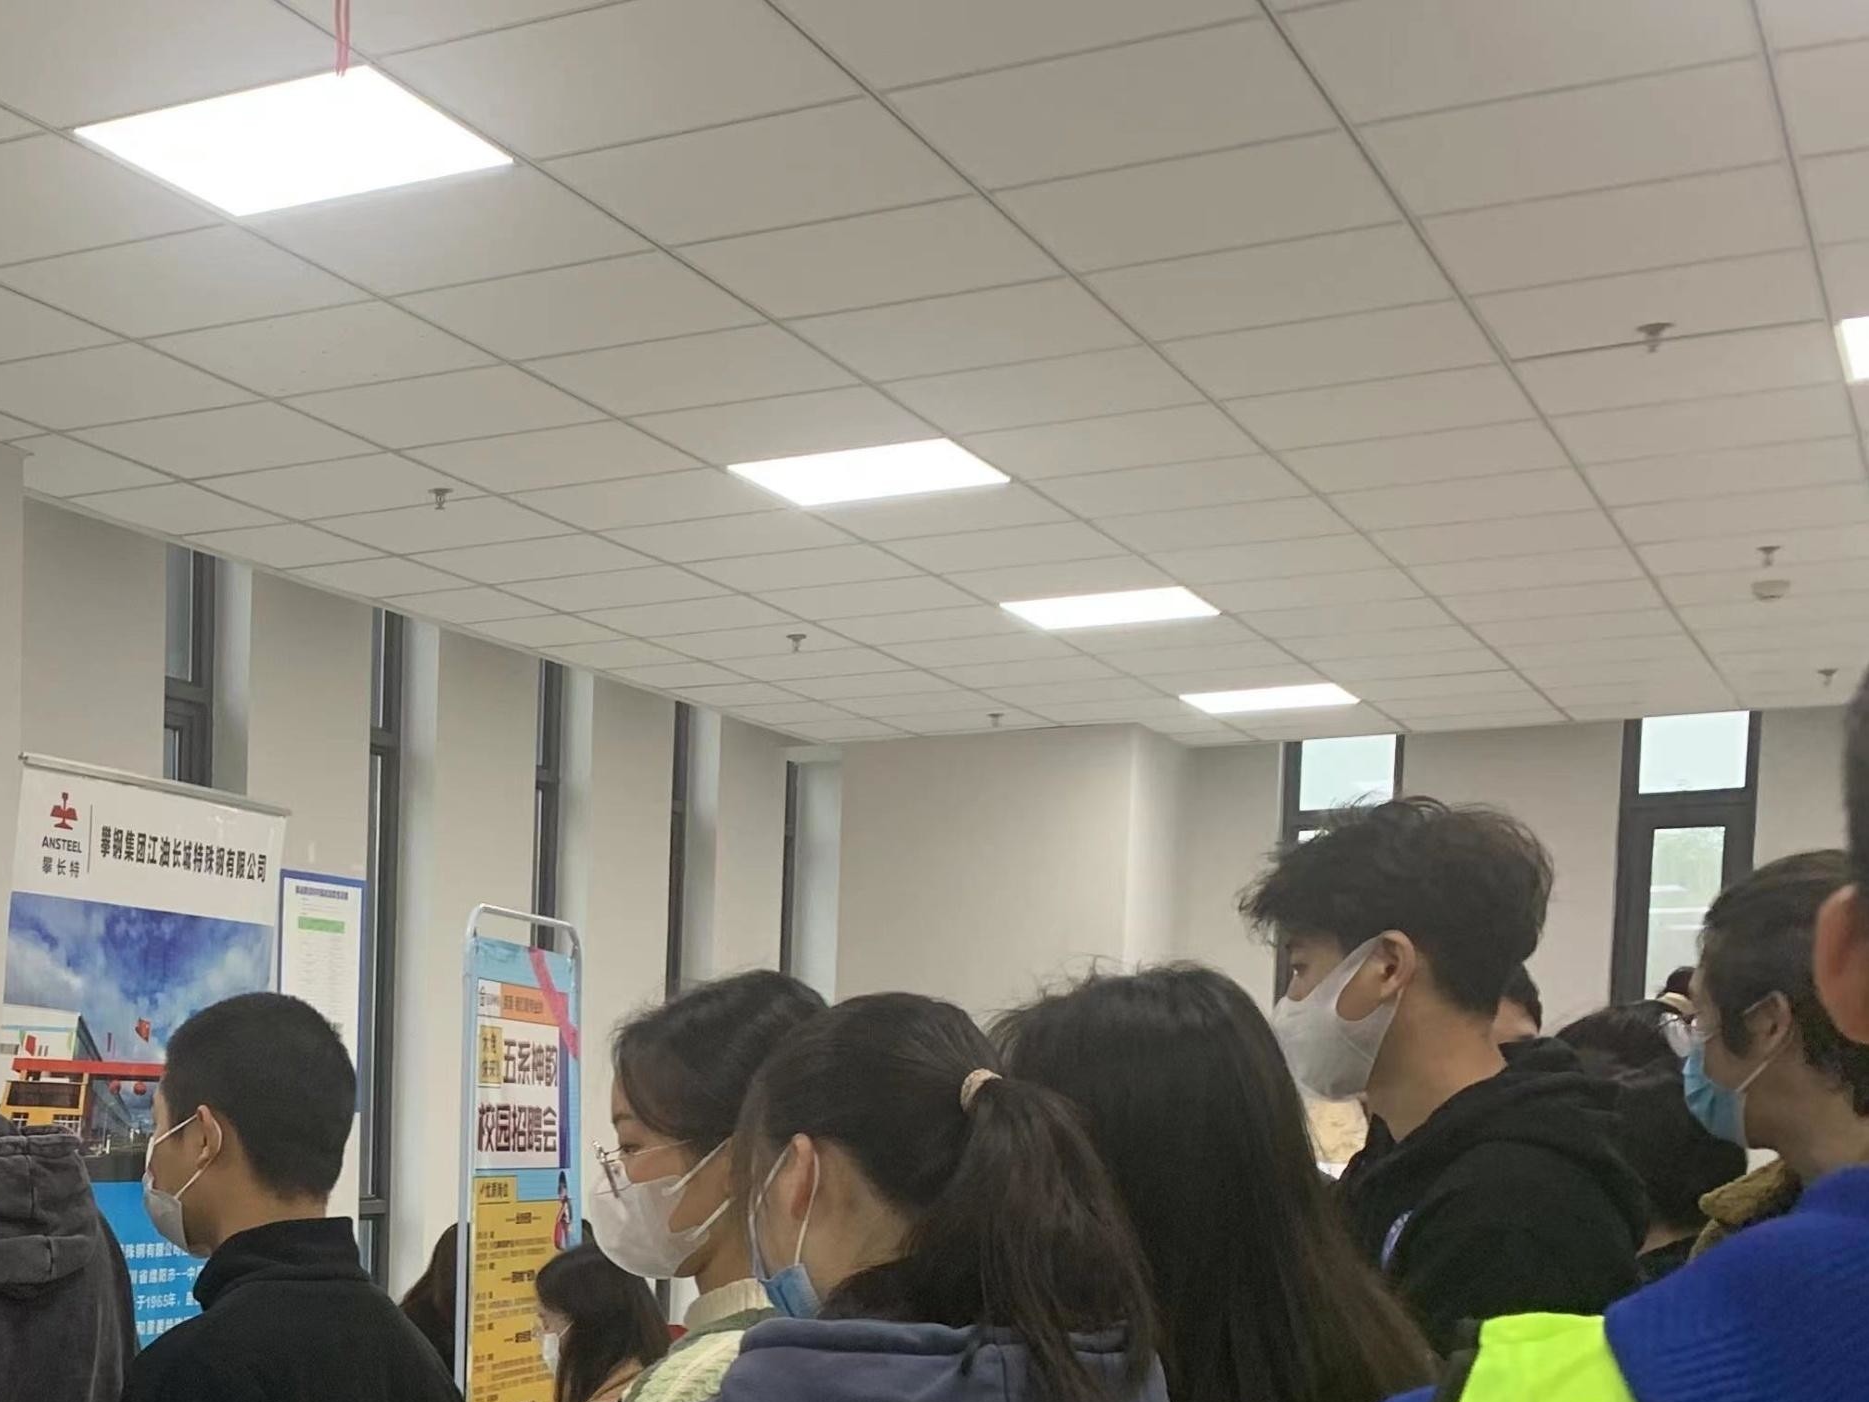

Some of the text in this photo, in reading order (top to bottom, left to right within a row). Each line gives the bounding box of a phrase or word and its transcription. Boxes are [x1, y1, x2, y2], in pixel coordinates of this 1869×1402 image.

[42, 836, 82, 853] ANSTEEL
[478, 1103, 557, 1152] 校园招聘会
